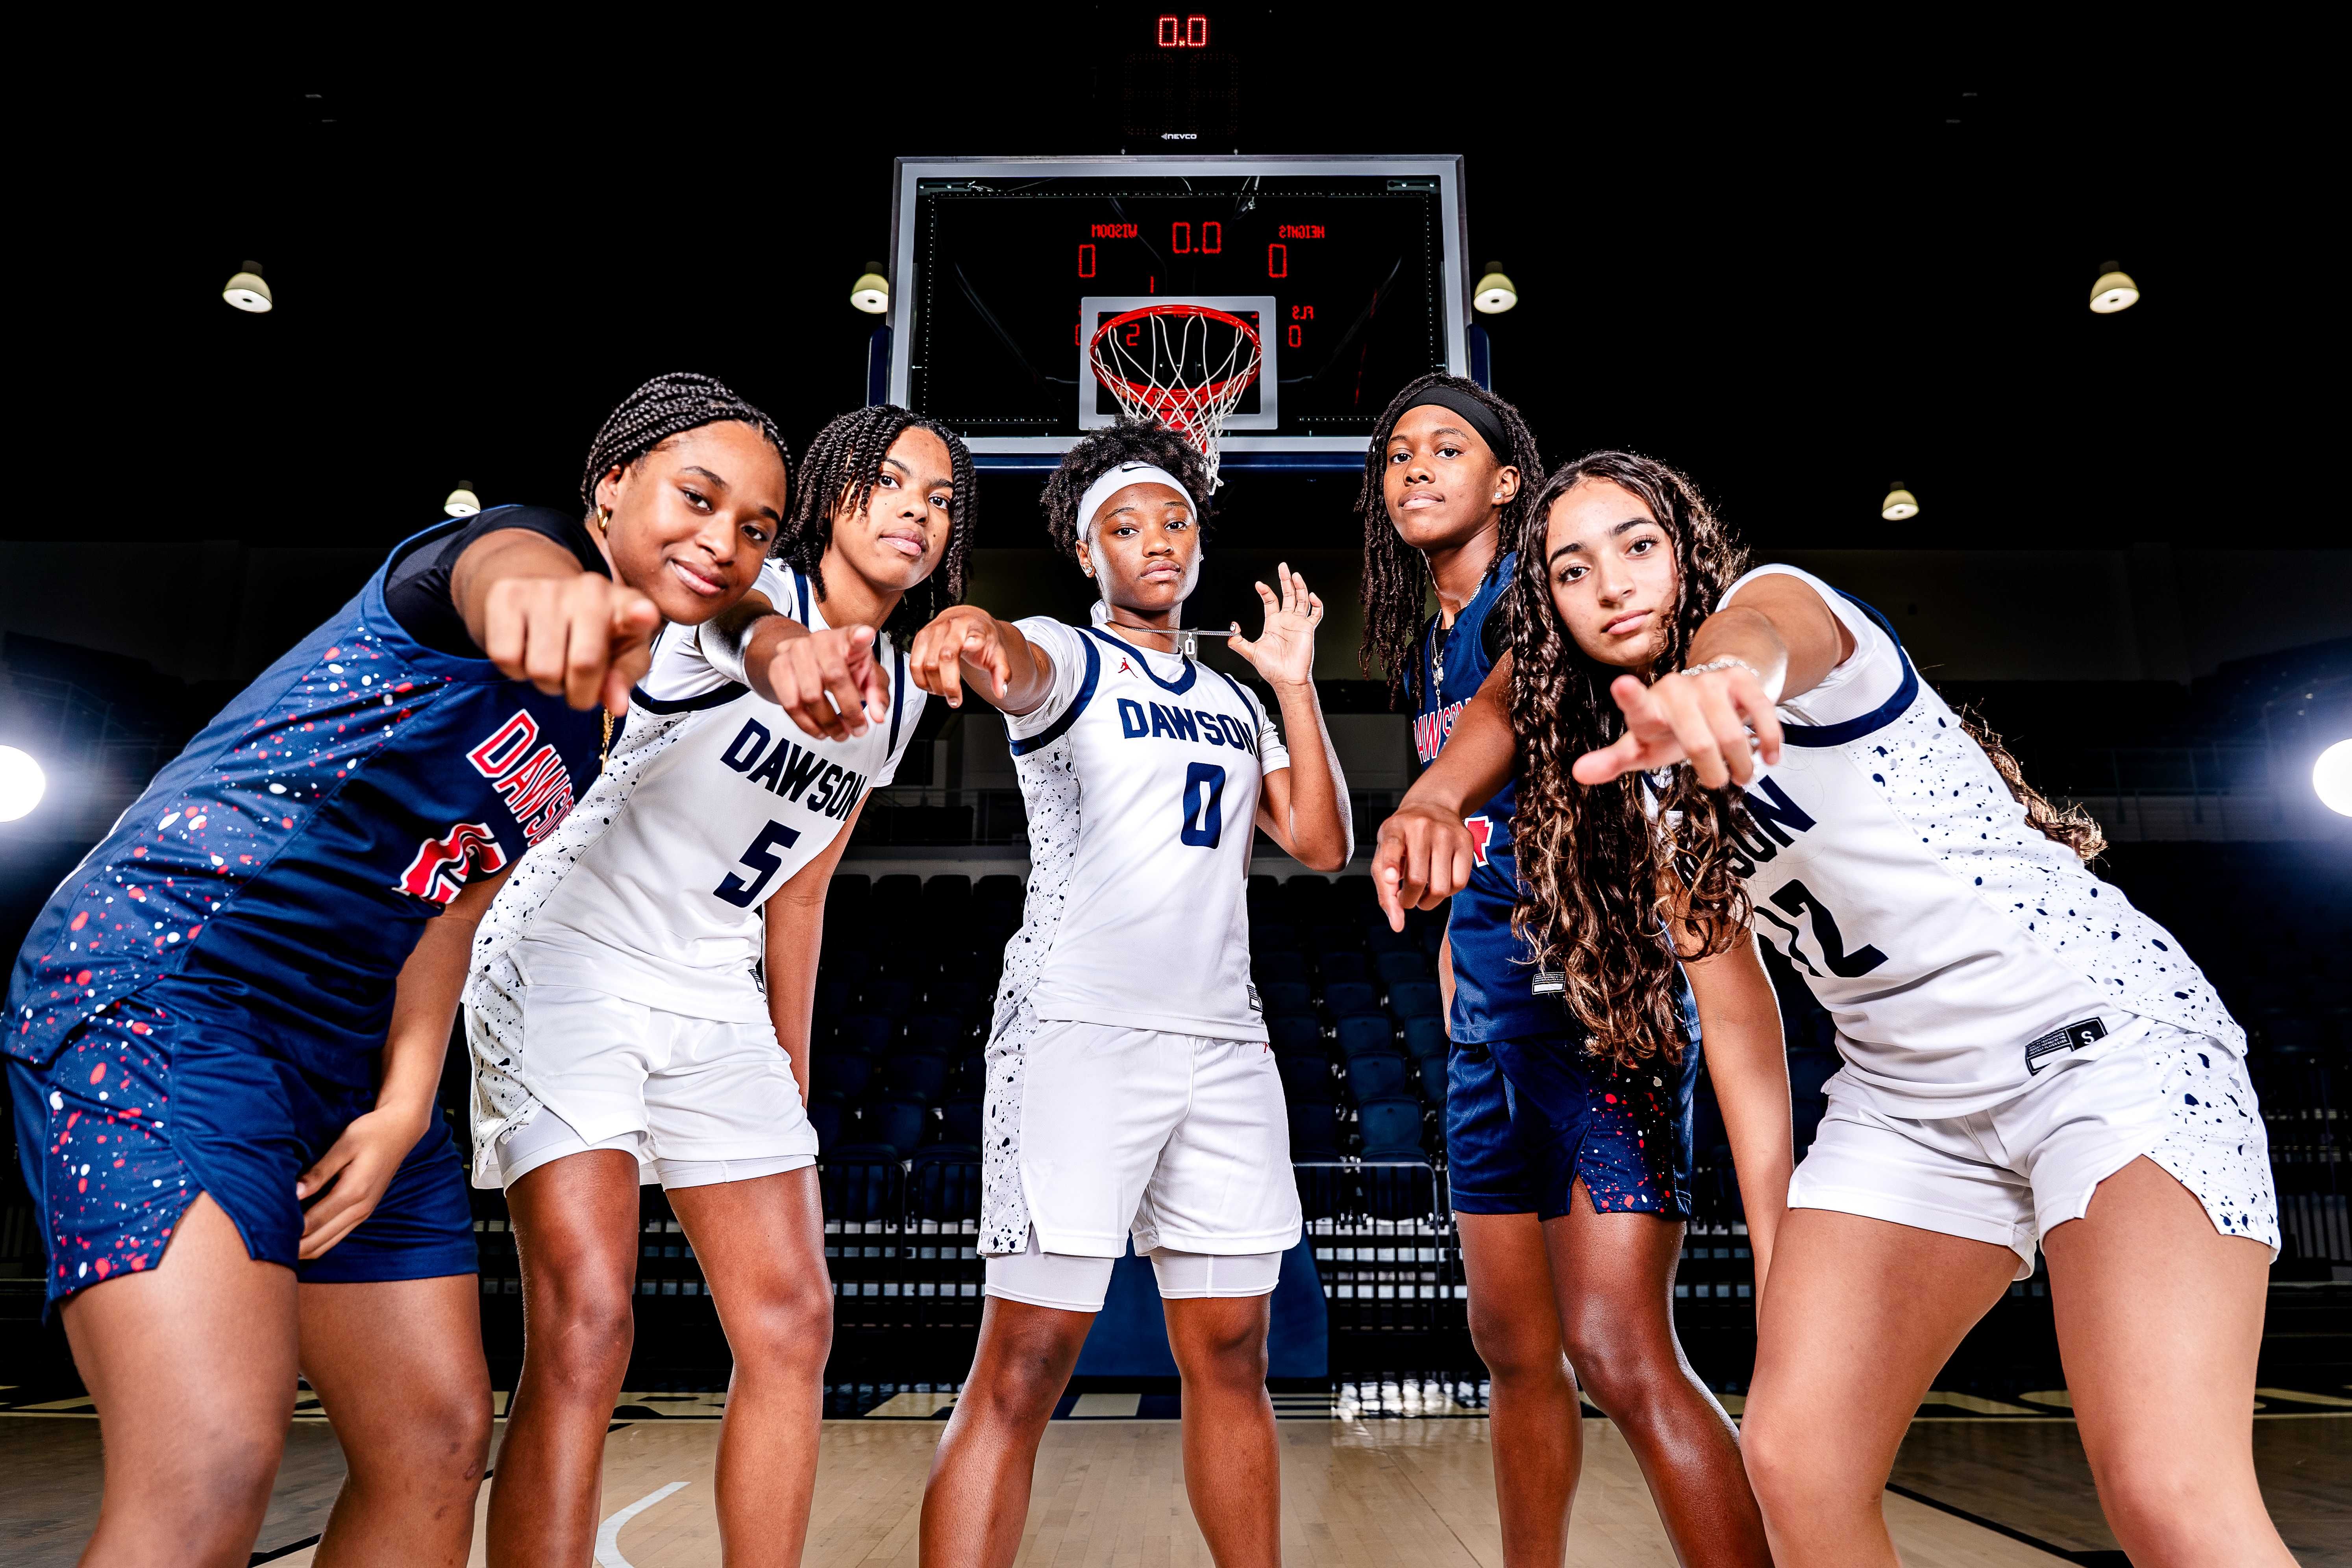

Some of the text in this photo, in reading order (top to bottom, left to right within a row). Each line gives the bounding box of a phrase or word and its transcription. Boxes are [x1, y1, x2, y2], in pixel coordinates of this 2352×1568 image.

[1158, 16, 1207, 47] 0.0
[720, 717, 868, 822] DAWSON
[1117, 698, 1259, 760] DAWSON
[466, 709, 575, 848] DAWSO
[1181, 762, 1226, 849] 0
[713, 819, 801, 908] 5
[2081, 1031, 2095, 1044] S
